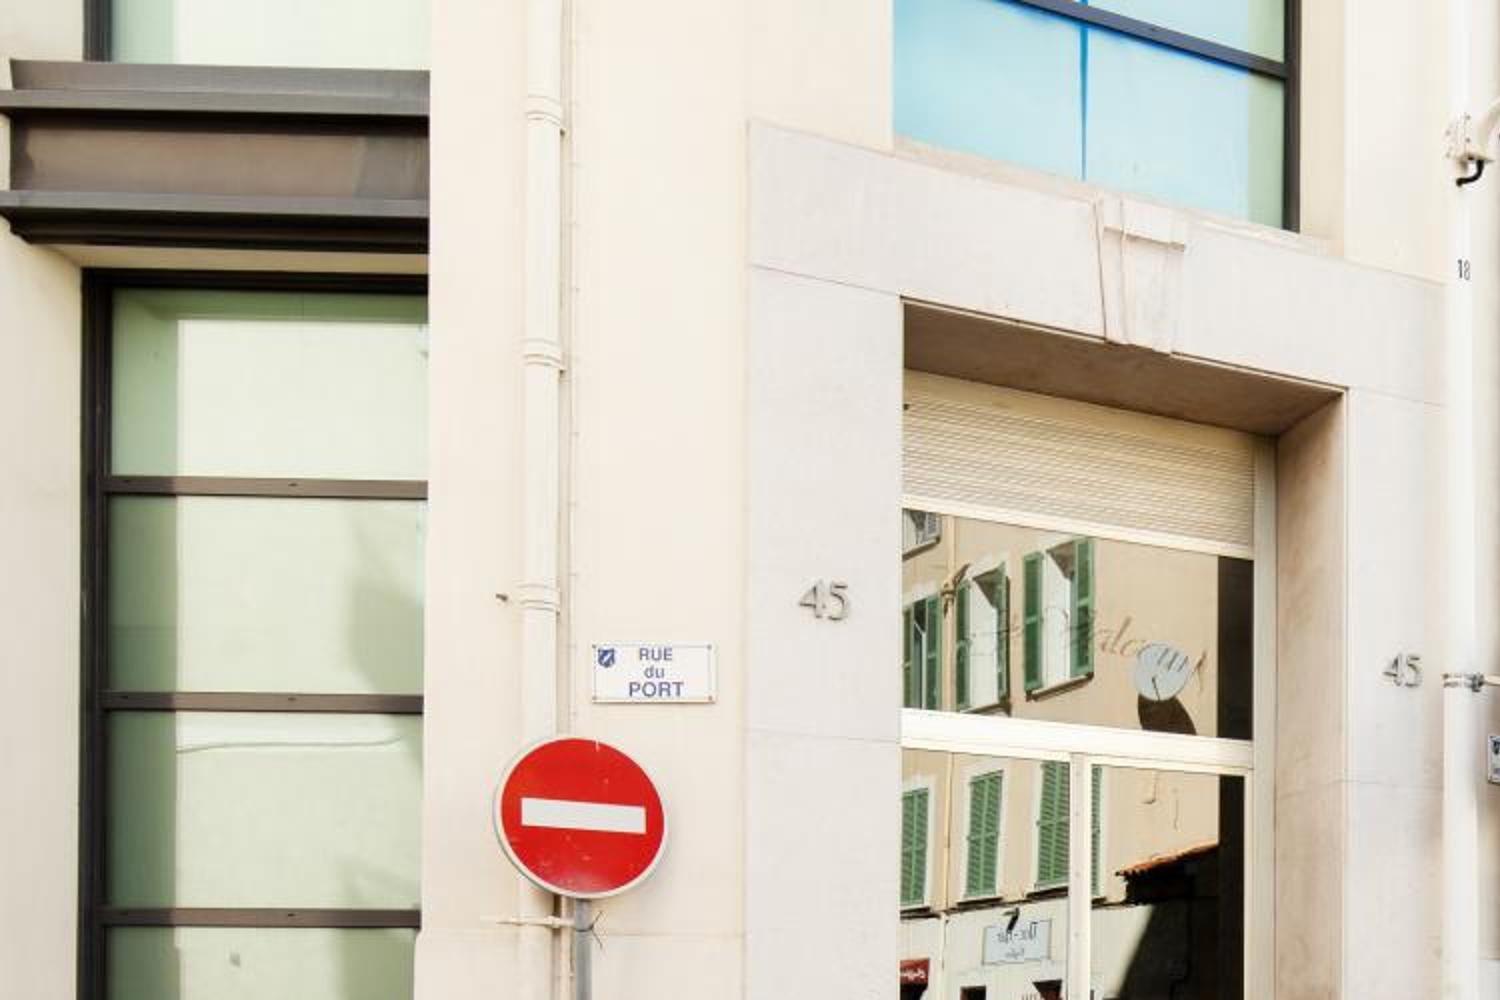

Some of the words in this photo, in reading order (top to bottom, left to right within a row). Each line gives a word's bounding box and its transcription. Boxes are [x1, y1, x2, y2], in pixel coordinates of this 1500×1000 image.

[799, 580, 848, 621] 45
[639, 647, 673, 661] RUE
[643, 667, 665, 679] du
[1382, 653, 1423, 688] 45
[629, 681, 684, 697] PORT
